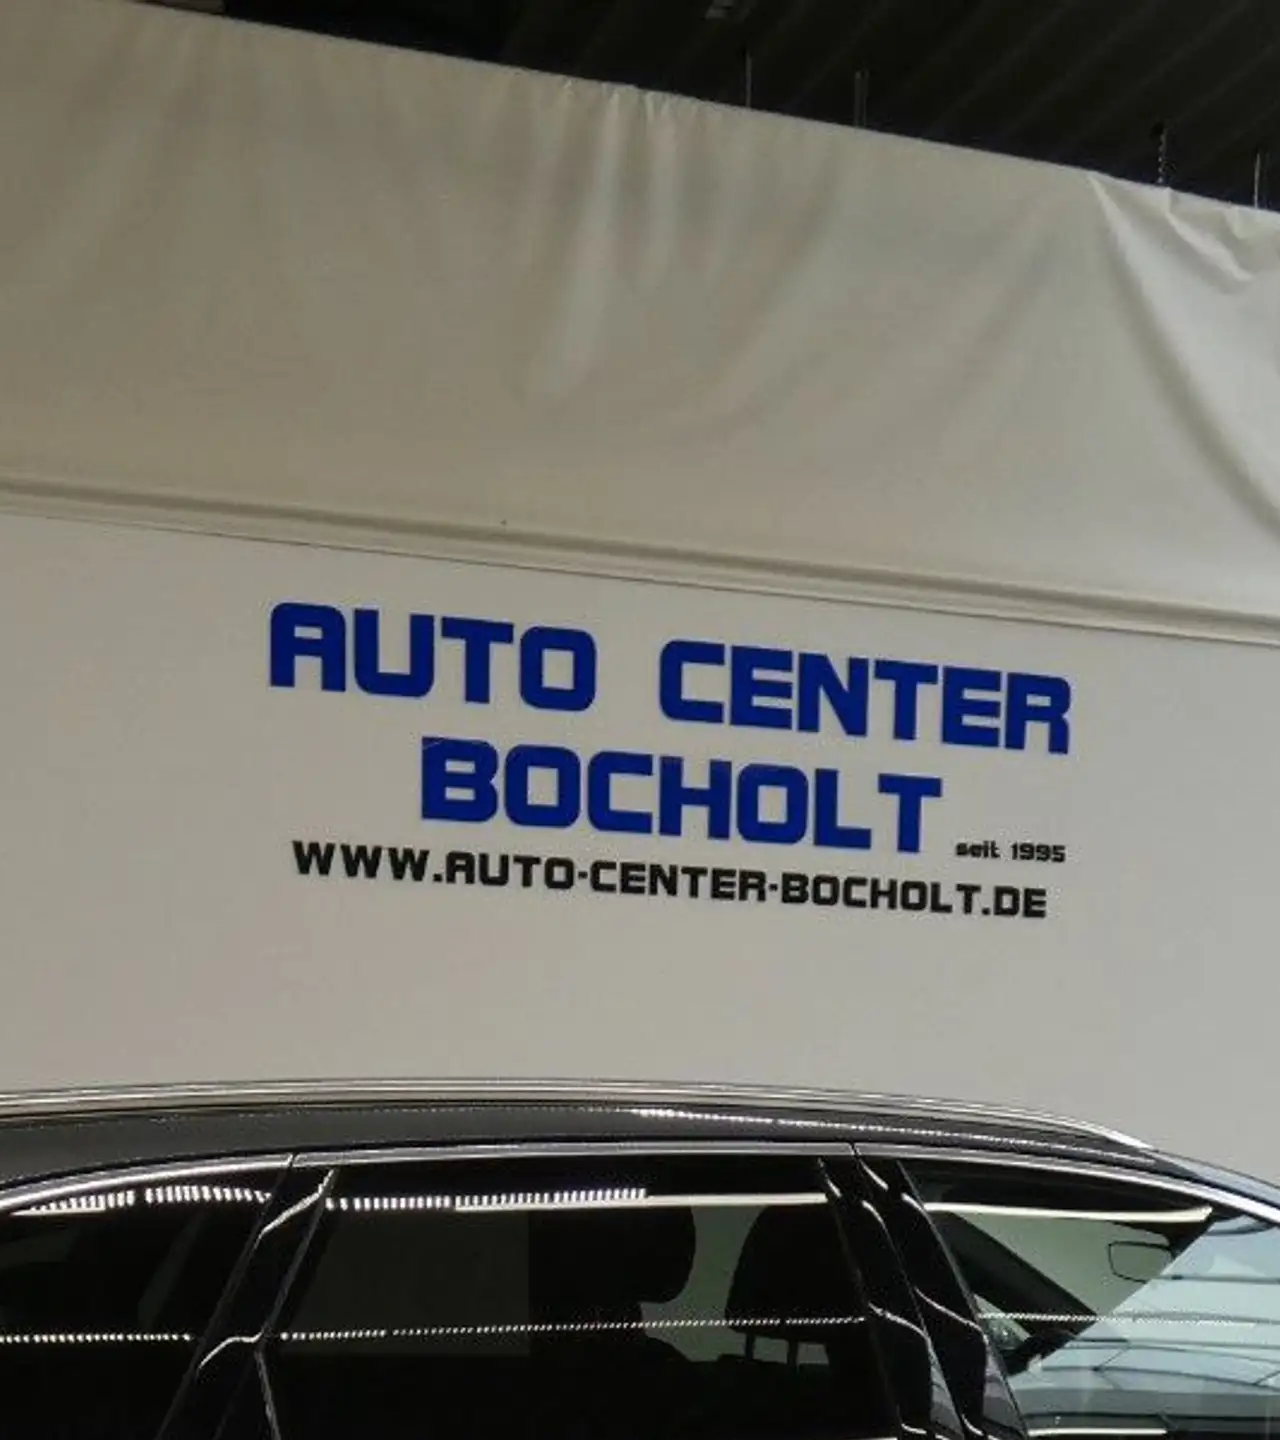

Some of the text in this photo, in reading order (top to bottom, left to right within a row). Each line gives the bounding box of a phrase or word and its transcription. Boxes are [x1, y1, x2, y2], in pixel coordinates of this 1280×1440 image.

[269, 601, 1072, 756] AUTO CENTER
[420, 735, 943, 854] BOCHOLT
[291, 840, 1048, 919] WWW.AUTO-CENTER-BOCHOLT.DE
[955, 840, 1066, 864] seit 1995
